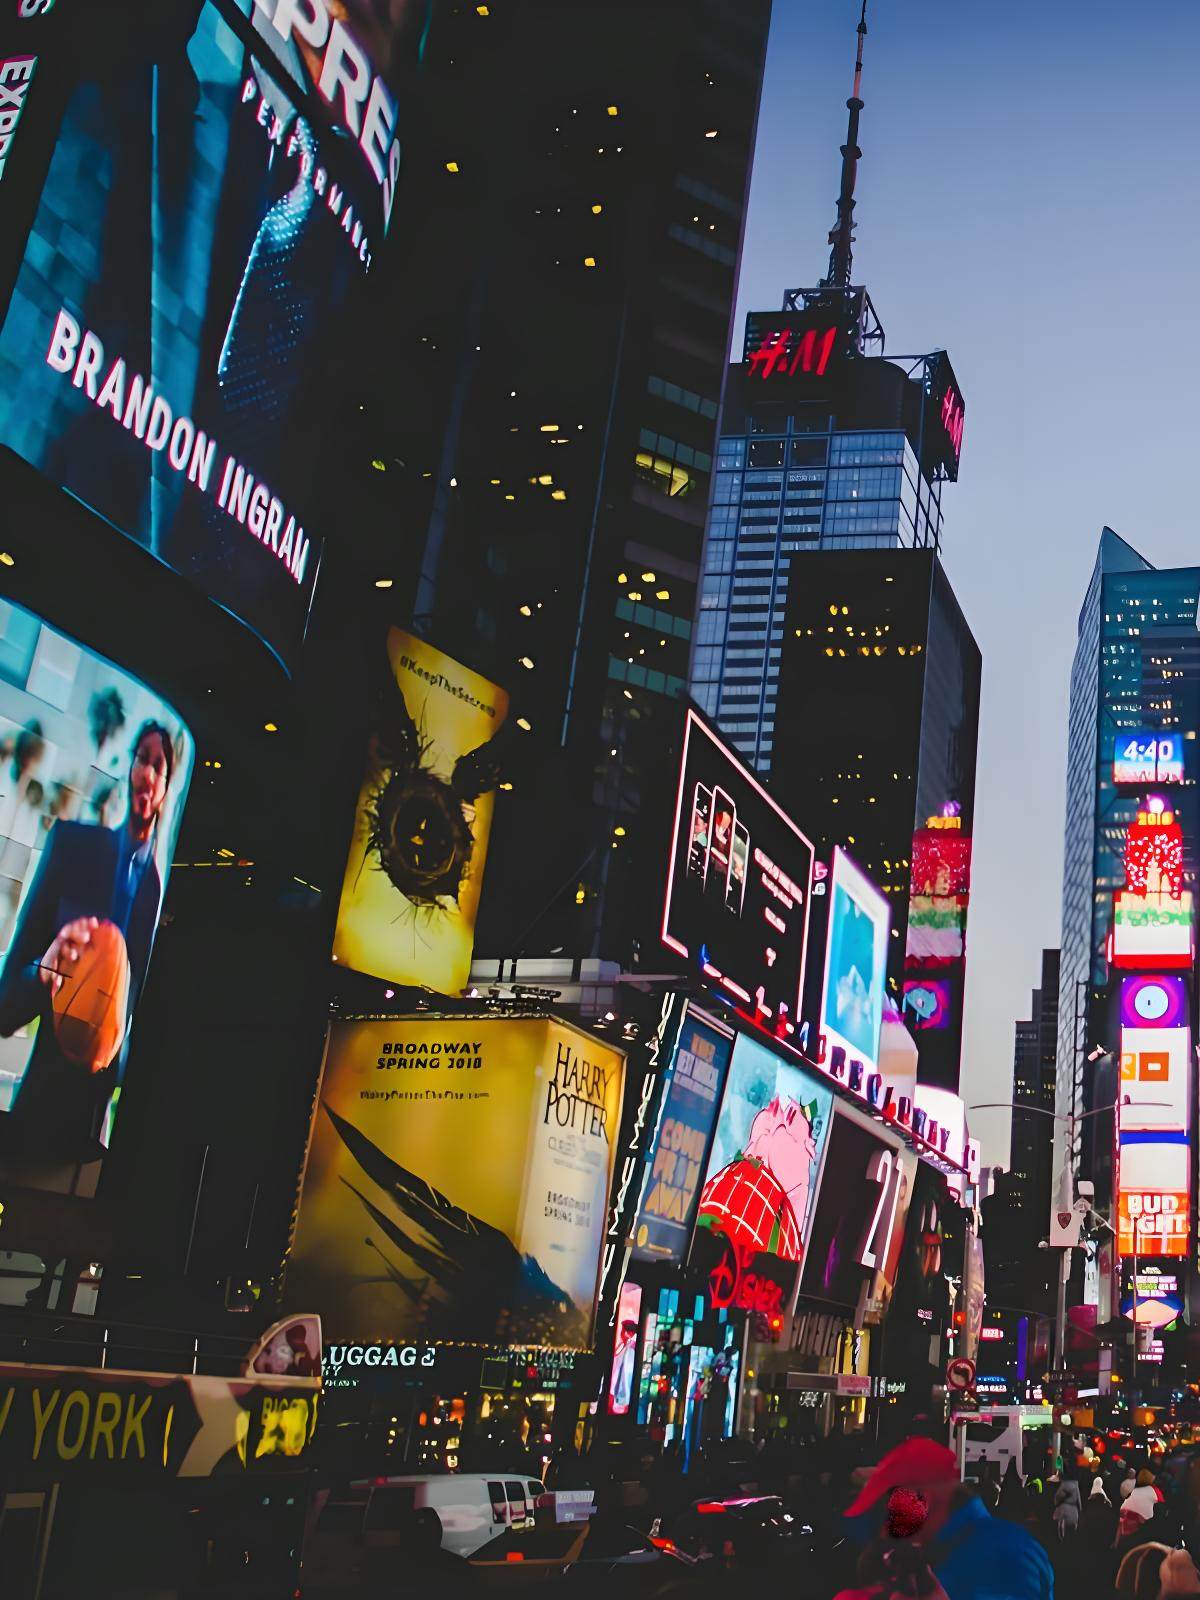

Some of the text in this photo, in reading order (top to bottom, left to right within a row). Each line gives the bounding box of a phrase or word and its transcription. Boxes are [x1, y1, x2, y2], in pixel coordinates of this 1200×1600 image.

[47, 307, 217, 491] BRANDON
[1123, 740, 1173, 761] 4:40
[376, 1057, 441, 1070] SPRING
[382, 1042, 482, 1055] BROADWAY
[554, 1042, 617, 1106] HARRY
[543, 1080, 609, 1145] POTTER
[1127, 1195, 1179, 1214] BUD
[31, 1388, 153, 1461] YORK
